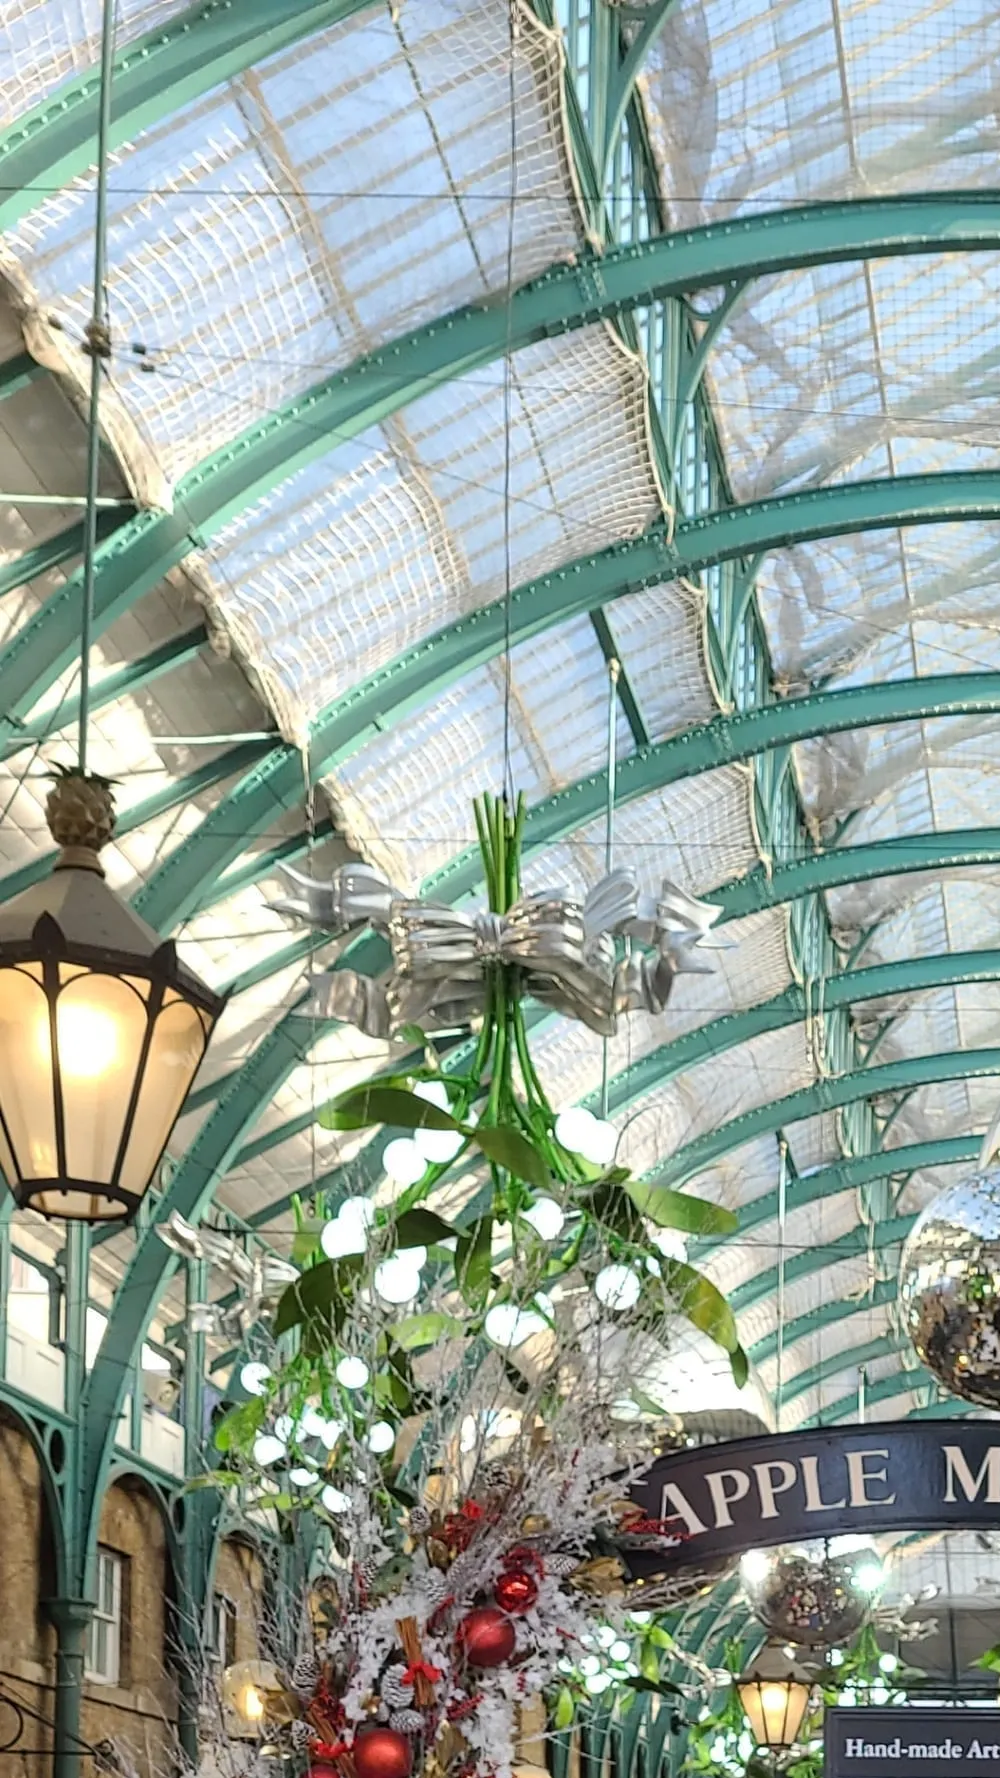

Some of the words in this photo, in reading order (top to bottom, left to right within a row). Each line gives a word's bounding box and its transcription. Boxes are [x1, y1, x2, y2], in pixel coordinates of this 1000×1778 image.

[657, 1450, 896, 1535] APPLE
[844, 1738, 962, 1760] Hand-made
[966, 1740, 1000, 1760] Art
